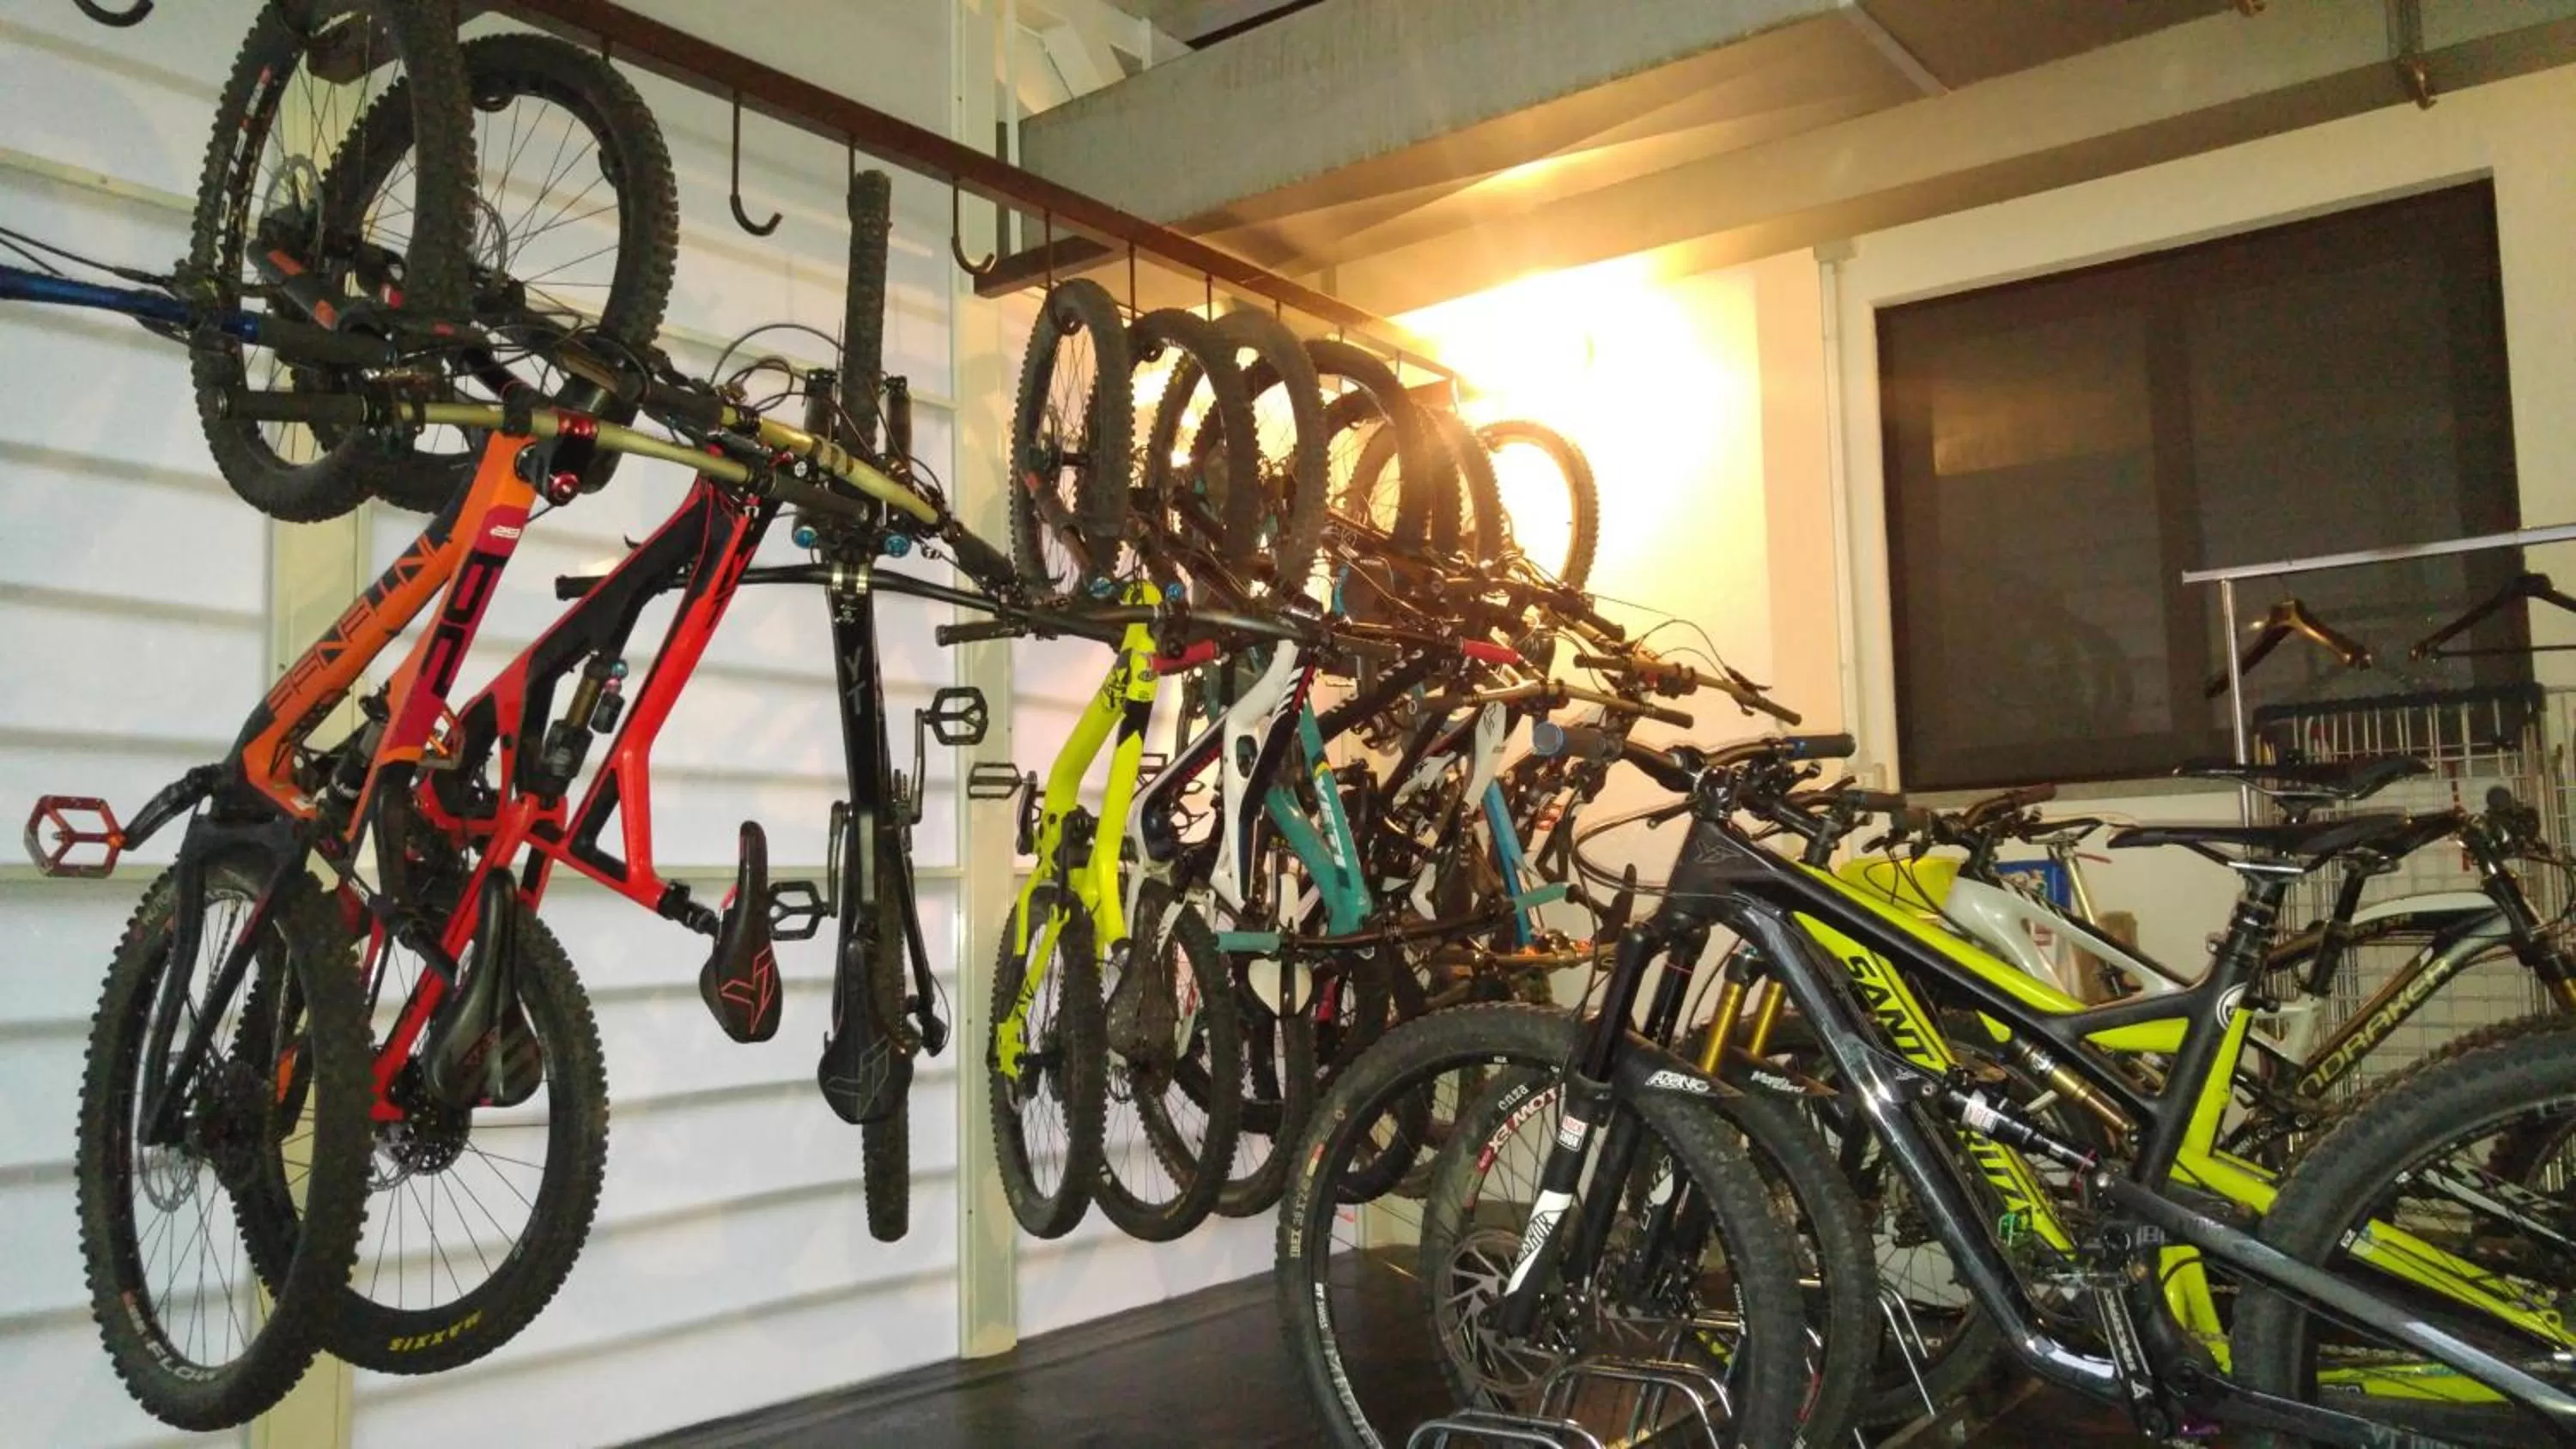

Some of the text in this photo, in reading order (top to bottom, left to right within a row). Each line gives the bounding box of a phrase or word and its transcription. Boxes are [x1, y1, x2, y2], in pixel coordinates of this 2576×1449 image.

[266, 533, 442, 713] INTENSE
[1848, 955, 1937, 1063] SANT
[2297, 957, 2451, 1096] NDRAKER
